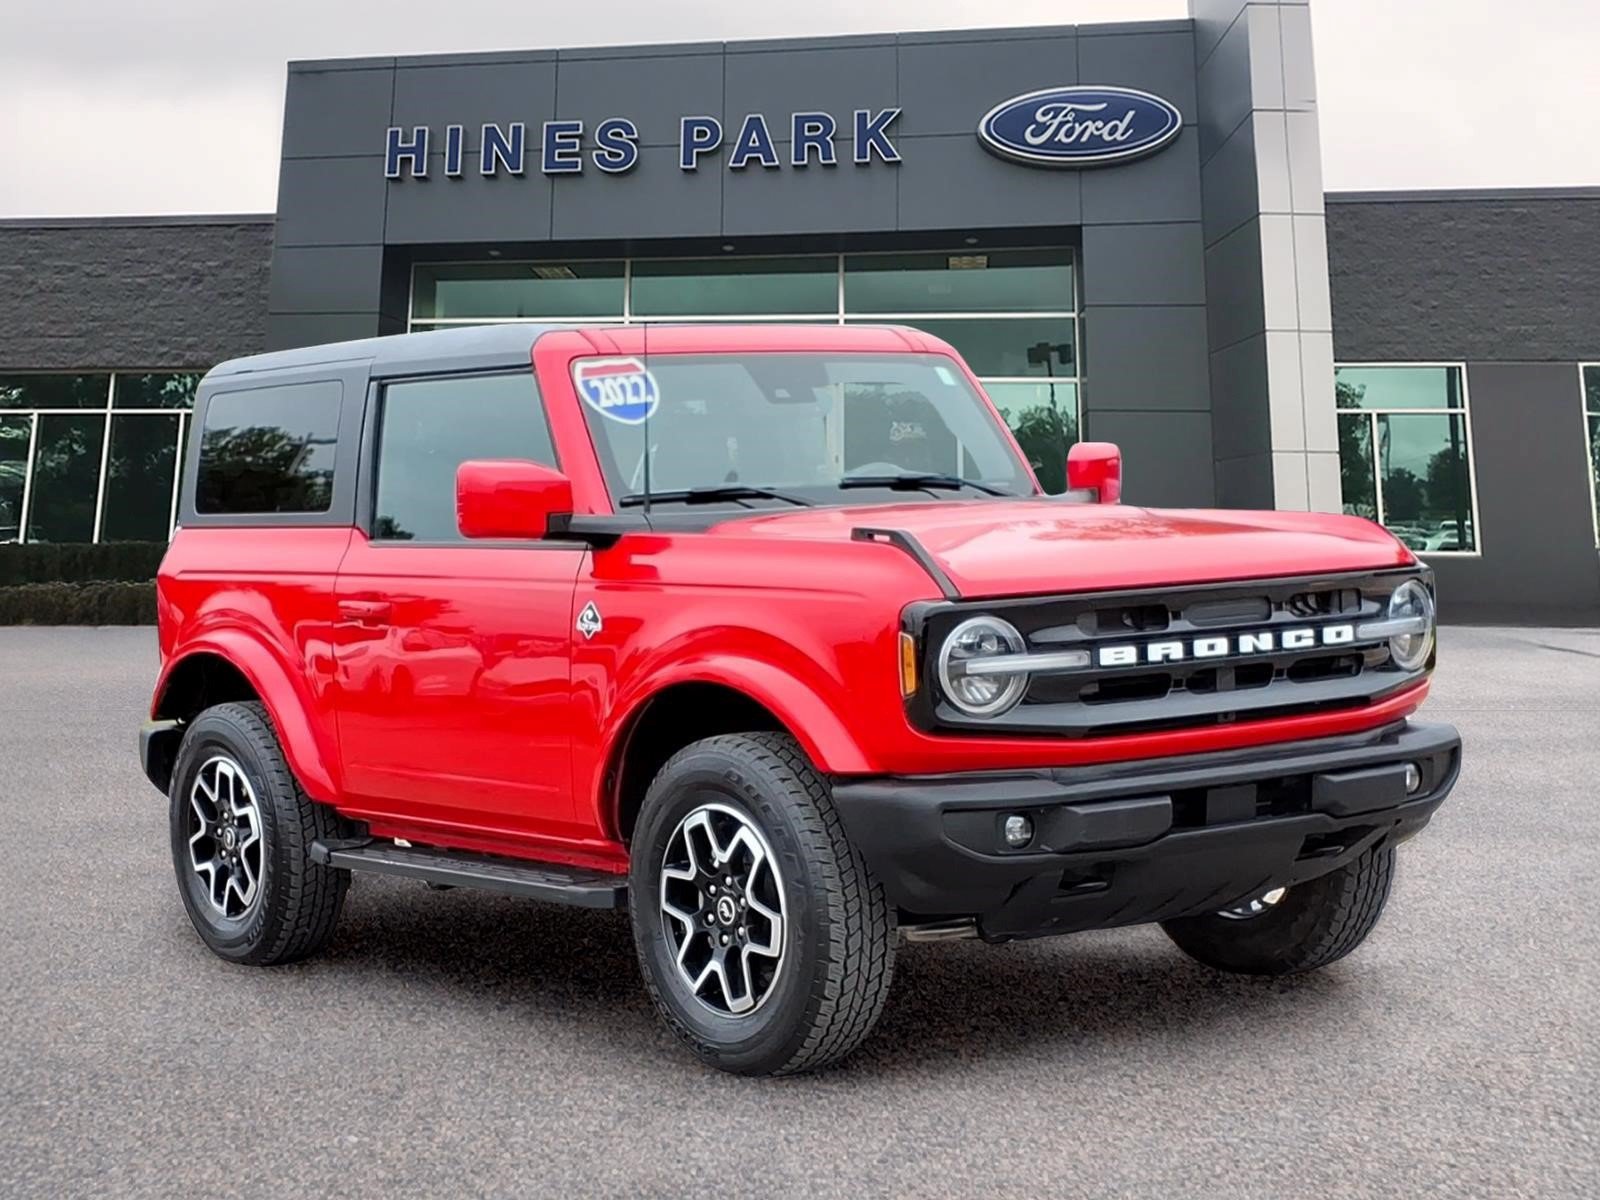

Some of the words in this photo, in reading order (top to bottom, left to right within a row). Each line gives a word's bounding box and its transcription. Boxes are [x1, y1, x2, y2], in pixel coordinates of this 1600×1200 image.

[384, 118, 639, 179] HINES
[679, 107, 902, 171] PARK
[1024, 102, 1136, 145] Ford
[589, 375, 654, 408] 2022
[1099, 624, 1354, 667] BRONCO
